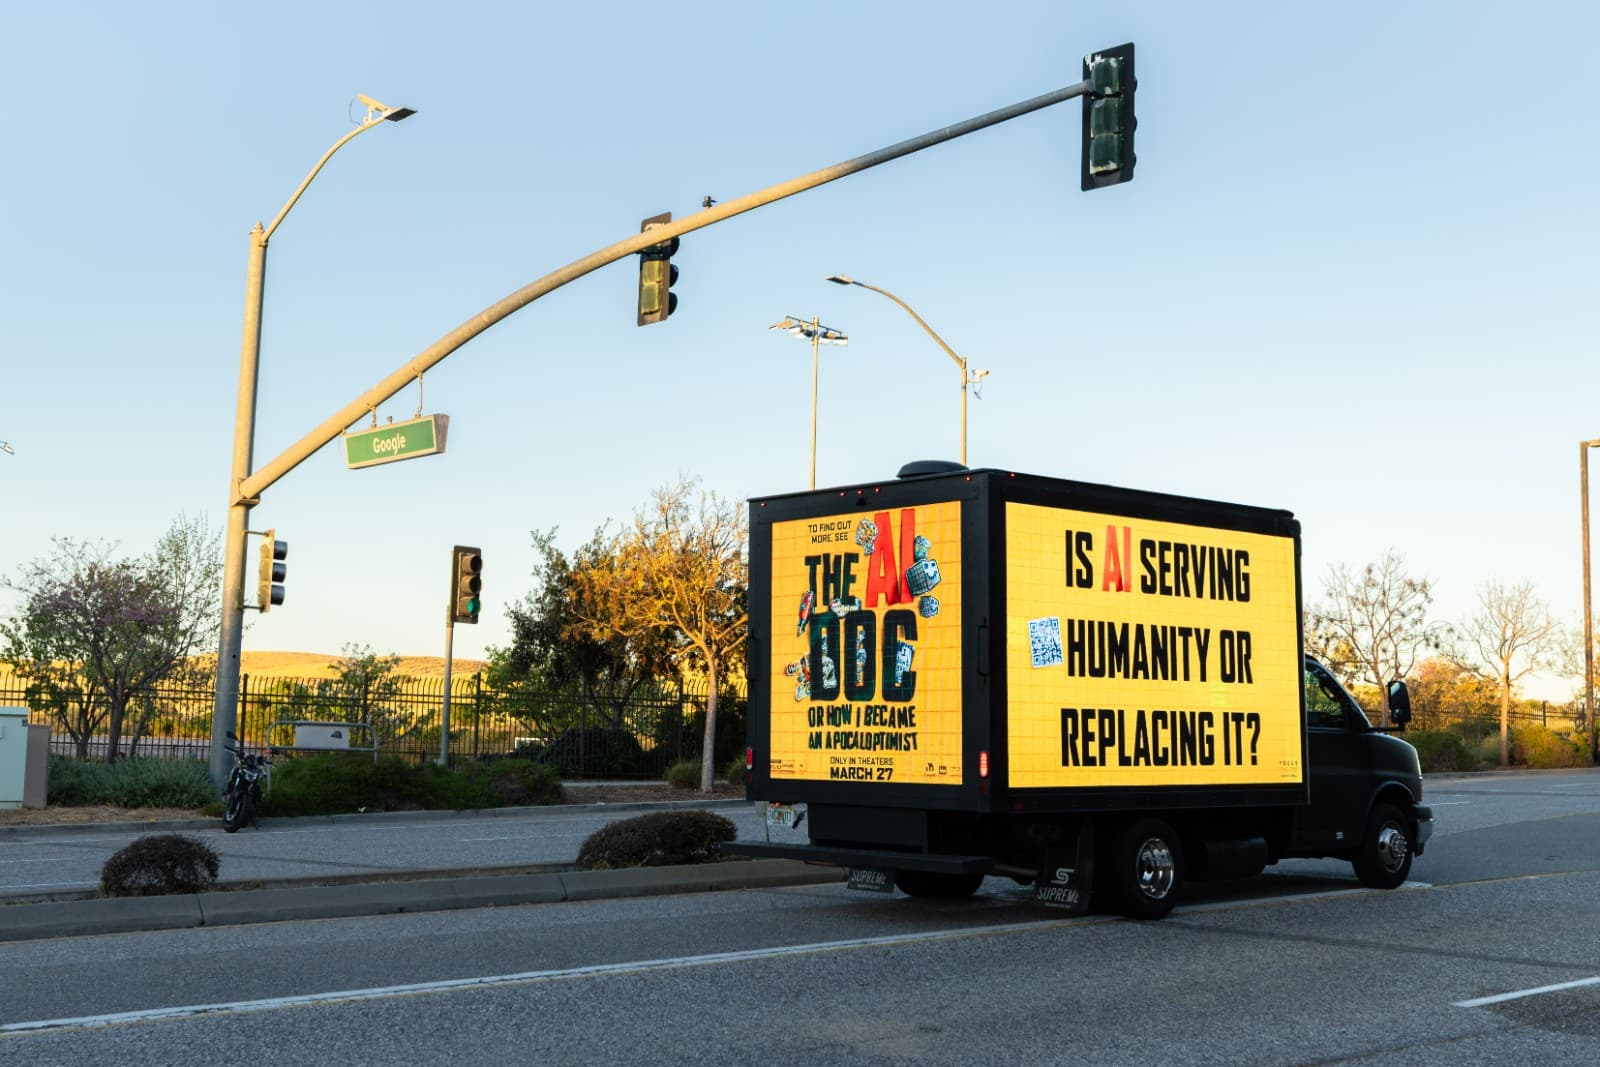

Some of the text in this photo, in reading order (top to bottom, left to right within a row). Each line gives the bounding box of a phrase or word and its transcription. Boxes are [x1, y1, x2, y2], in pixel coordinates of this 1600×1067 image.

[373, 433, 406, 455] Google
[808, 520, 852, 533] TO FIND OUT
[835, 532, 848, 541] SEE
[805, 508, 916, 608] THE AI
[1065, 525, 1250, 602] IS AI SERVING
[809, 609, 918, 701] DOC
[1067, 619, 1253, 684] HUMANITY OR
[808, 704, 916, 728] OR HOW I BECAME
[808, 731, 918, 751] AN APOCALOPTIMIST
[1060, 708, 1261, 767] REPLACING IT?
[830, 756, 847, 764] ONLY
[857, 757, 893, 765] THEATERS
[830, 767, 893, 780] MARCH 27
